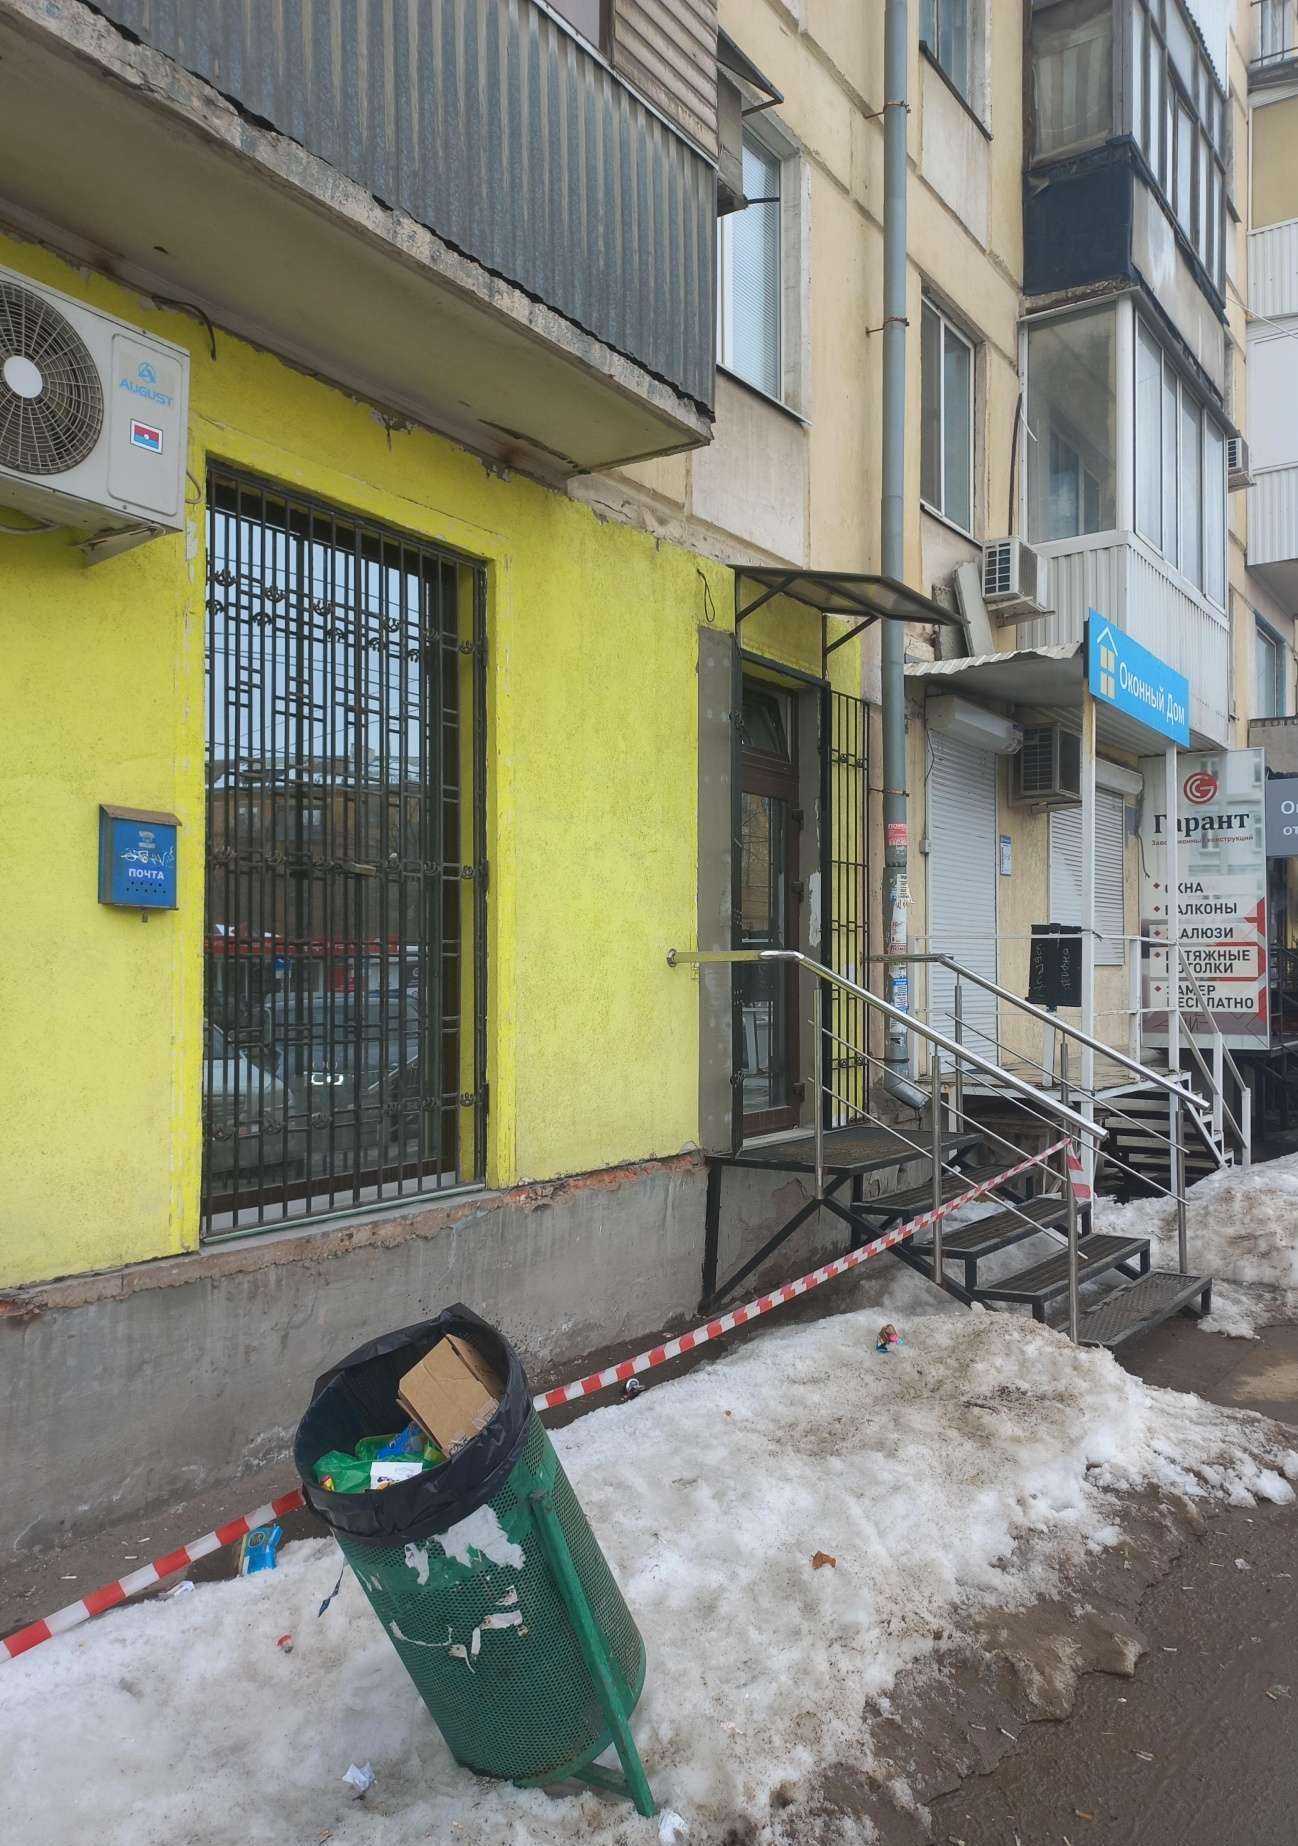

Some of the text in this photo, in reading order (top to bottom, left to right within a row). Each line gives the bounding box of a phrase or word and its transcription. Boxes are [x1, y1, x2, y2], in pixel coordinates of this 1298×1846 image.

[119, 378, 174, 404] AUGUST
[1119, 661, 1185, 727] Оконный Дом
[128, 868, 165, 880] ПОЧТА
[1166, 927, 1234, 939] АЛЮЗИ
[1165, 949, 1251, 961] ТЯЖНЫЕ
